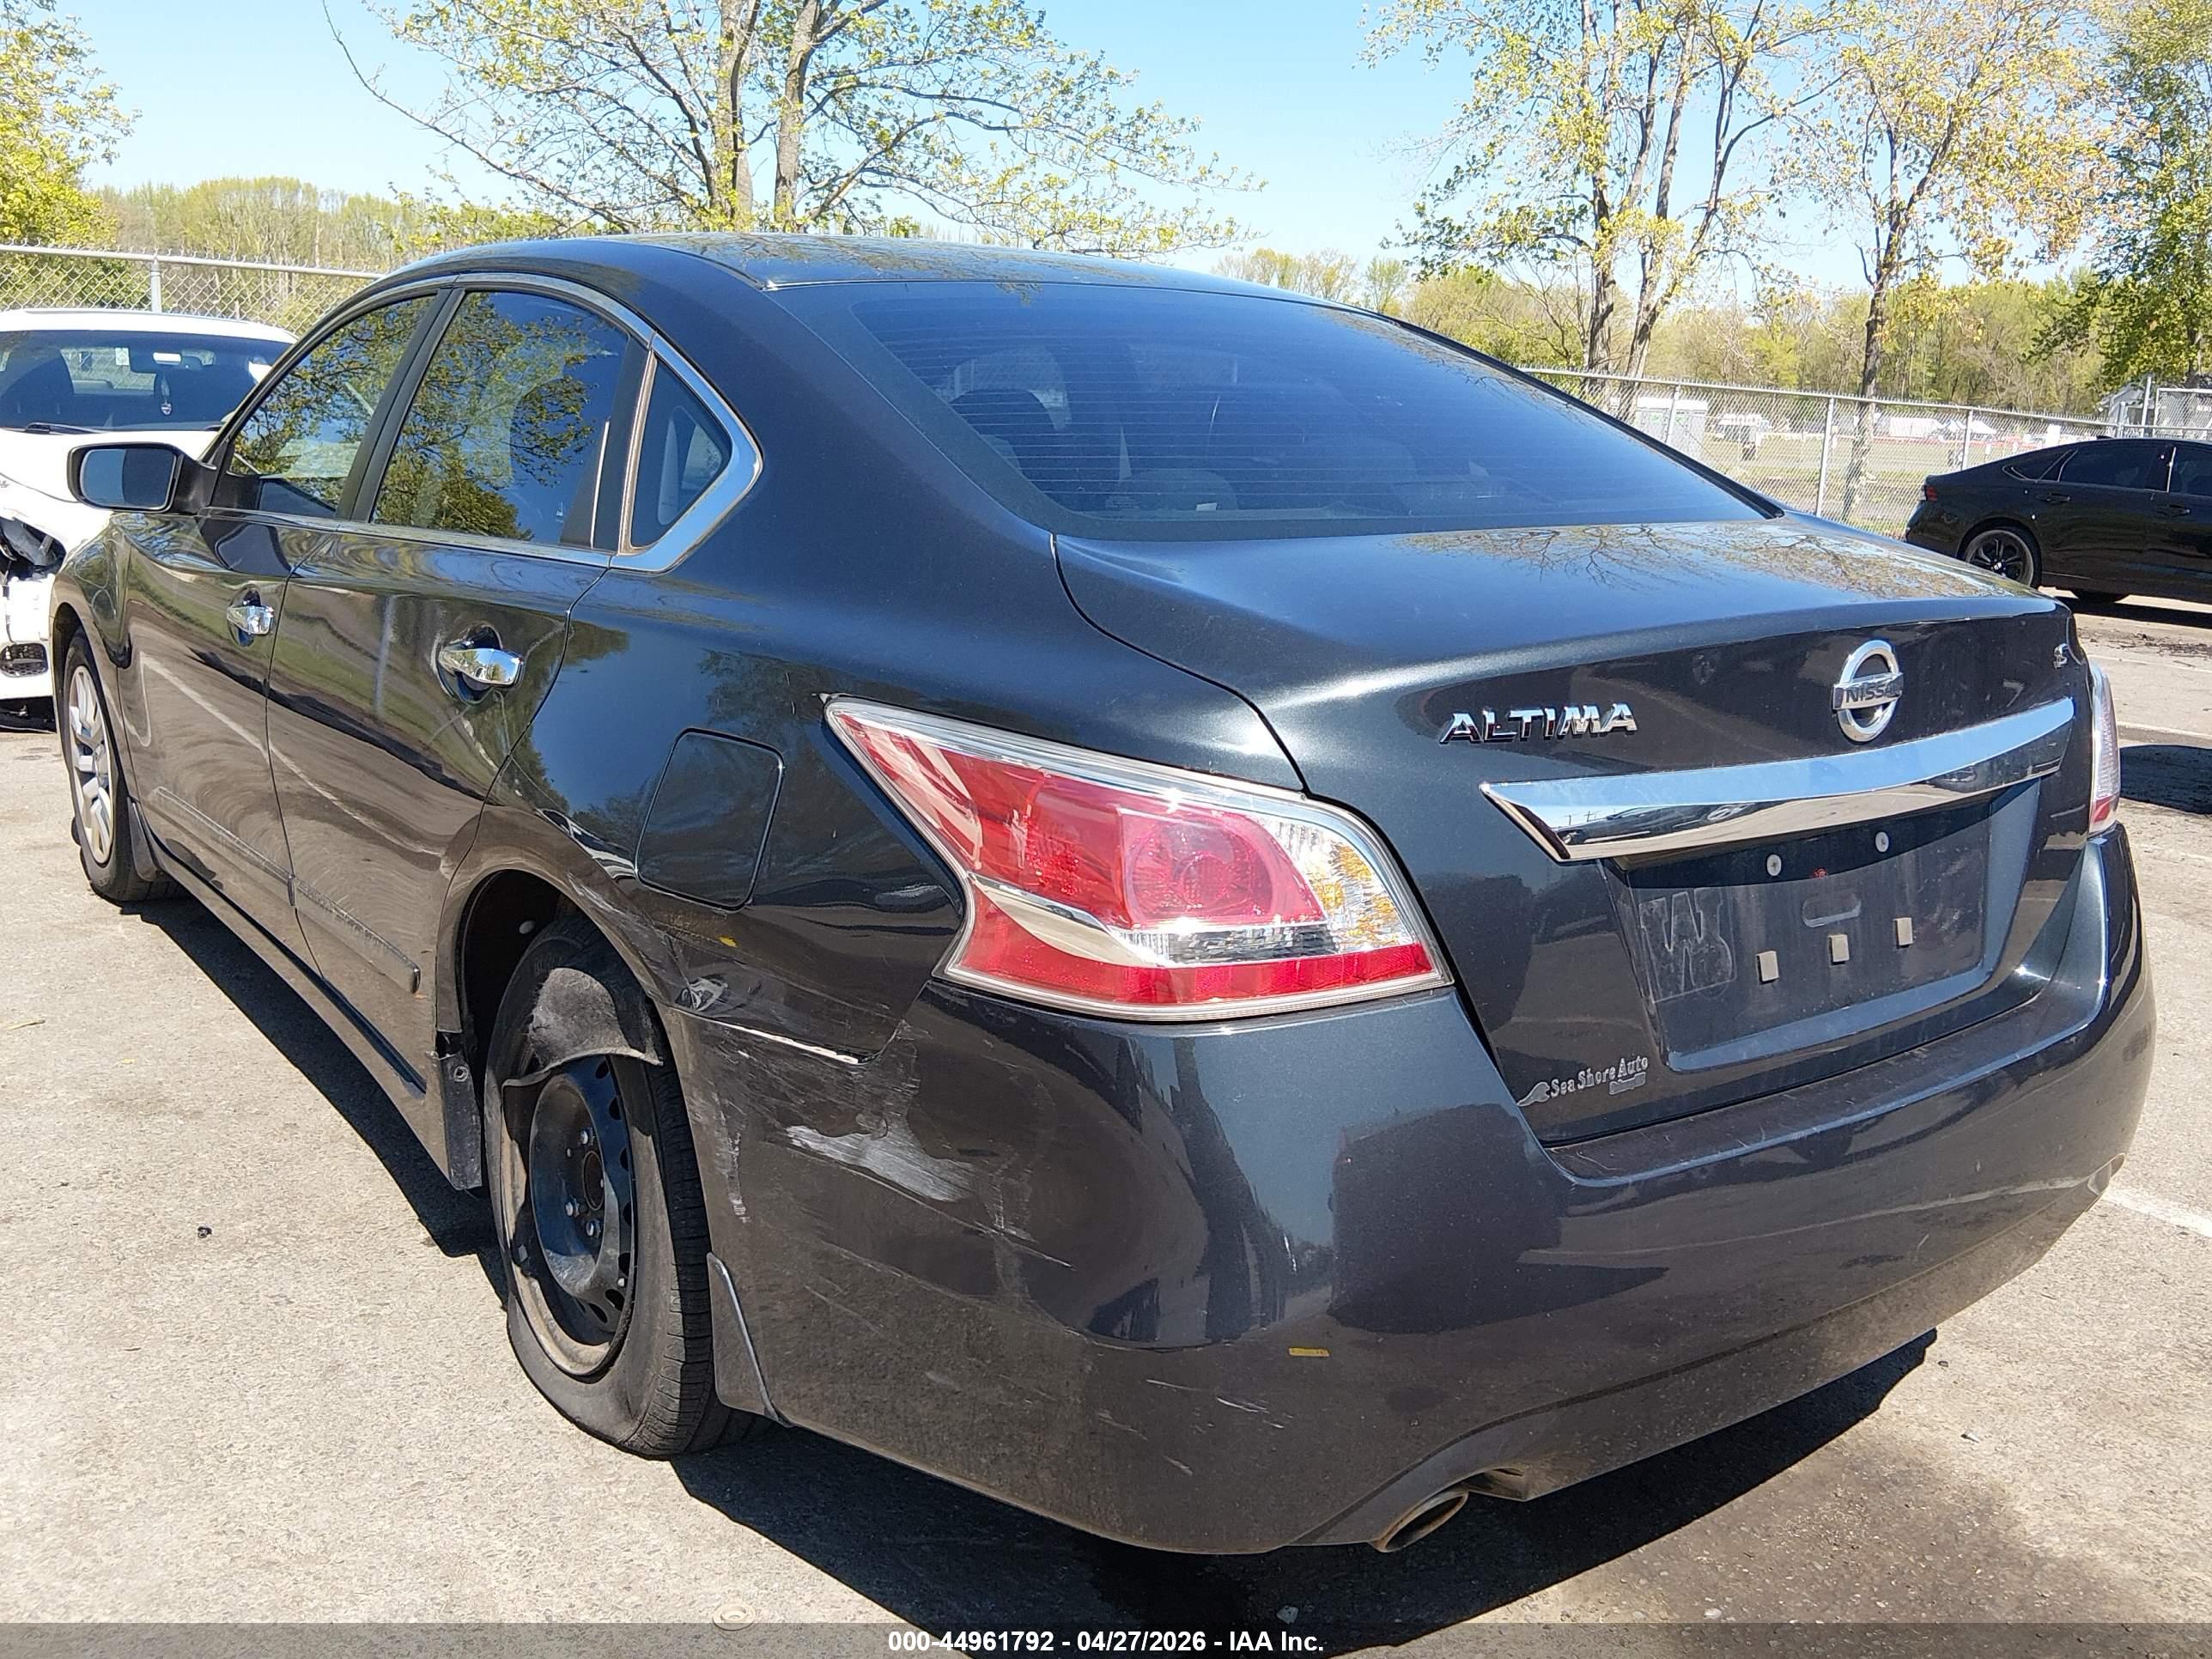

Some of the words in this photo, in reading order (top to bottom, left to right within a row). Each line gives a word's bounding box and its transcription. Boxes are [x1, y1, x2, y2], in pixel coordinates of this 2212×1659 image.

[1845, 678, 1902, 703] NISSA
[1439, 702, 1638, 744] ALTIMA
[1550, 1078, 1577, 1098] Sea
[1577, 1067, 1616, 1091] Shore
[1617, 1055, 1649, 1078] Auto
